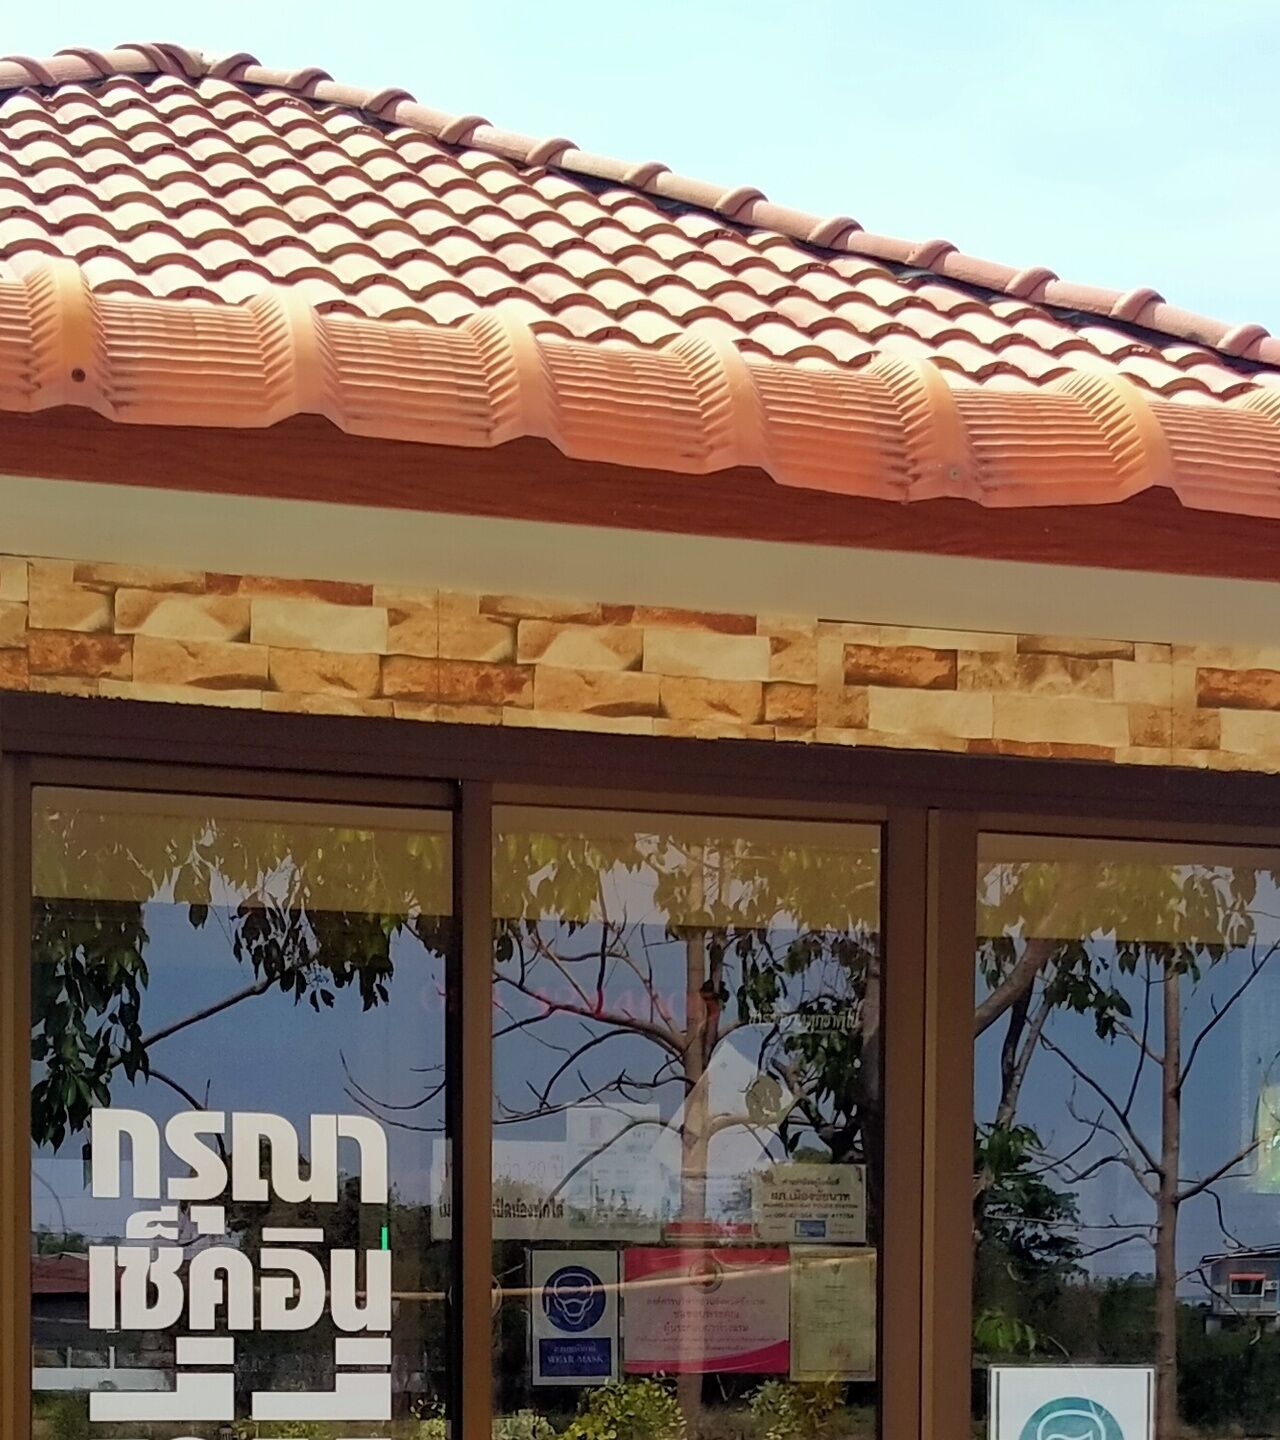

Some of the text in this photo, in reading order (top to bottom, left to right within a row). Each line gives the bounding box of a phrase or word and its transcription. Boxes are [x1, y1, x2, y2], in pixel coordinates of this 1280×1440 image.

[90, 1107, 389, 1234] กรุณา
[88, 1205, 392, 1332] เช็คอิน
